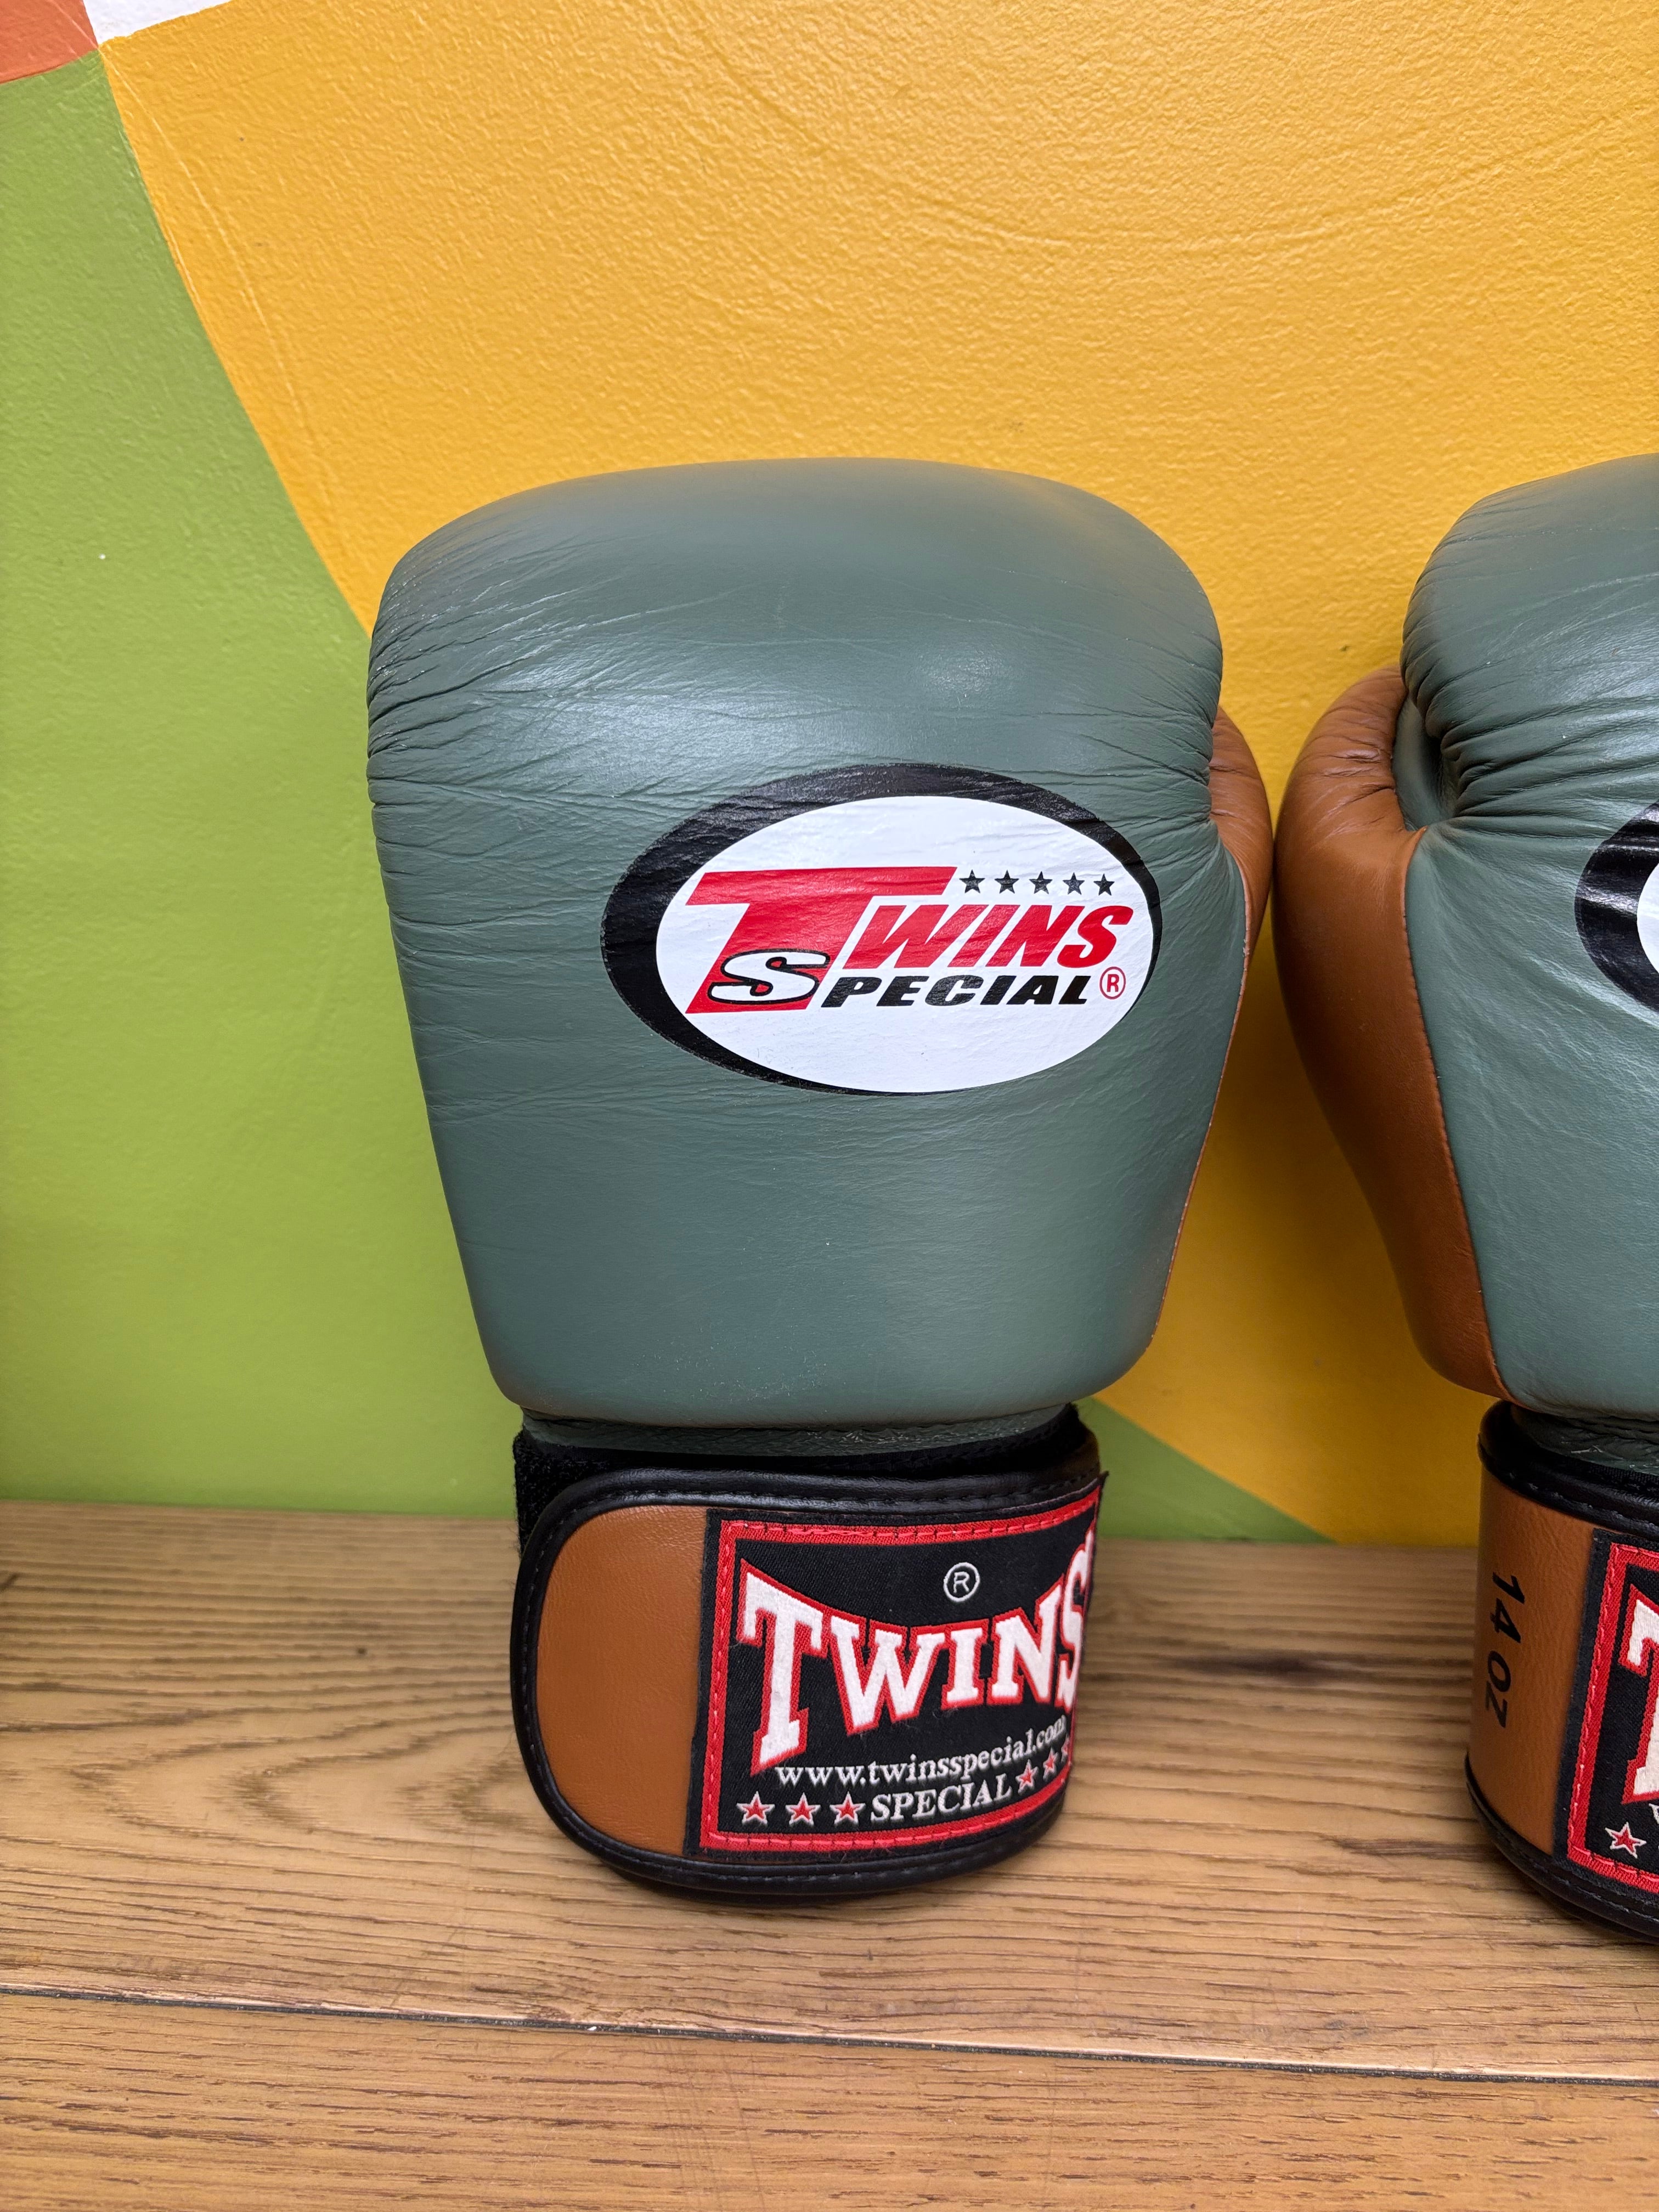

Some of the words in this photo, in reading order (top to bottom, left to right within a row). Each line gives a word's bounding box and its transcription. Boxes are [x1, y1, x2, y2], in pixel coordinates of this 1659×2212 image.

[685, 866, 1133, 1014] TWINS
[708, 949, 1088, 1008] SPECIAL
[1489, 1571, 1525, 1644] 14
[736, 1524, 1096, 1776] TWINS
[1485, 1650, 1512, 1728] OZ
[774, 1714, 1067, 1787] www.twinsspecial.com
[870, 1774, 1012, 1824] SPECIAL
